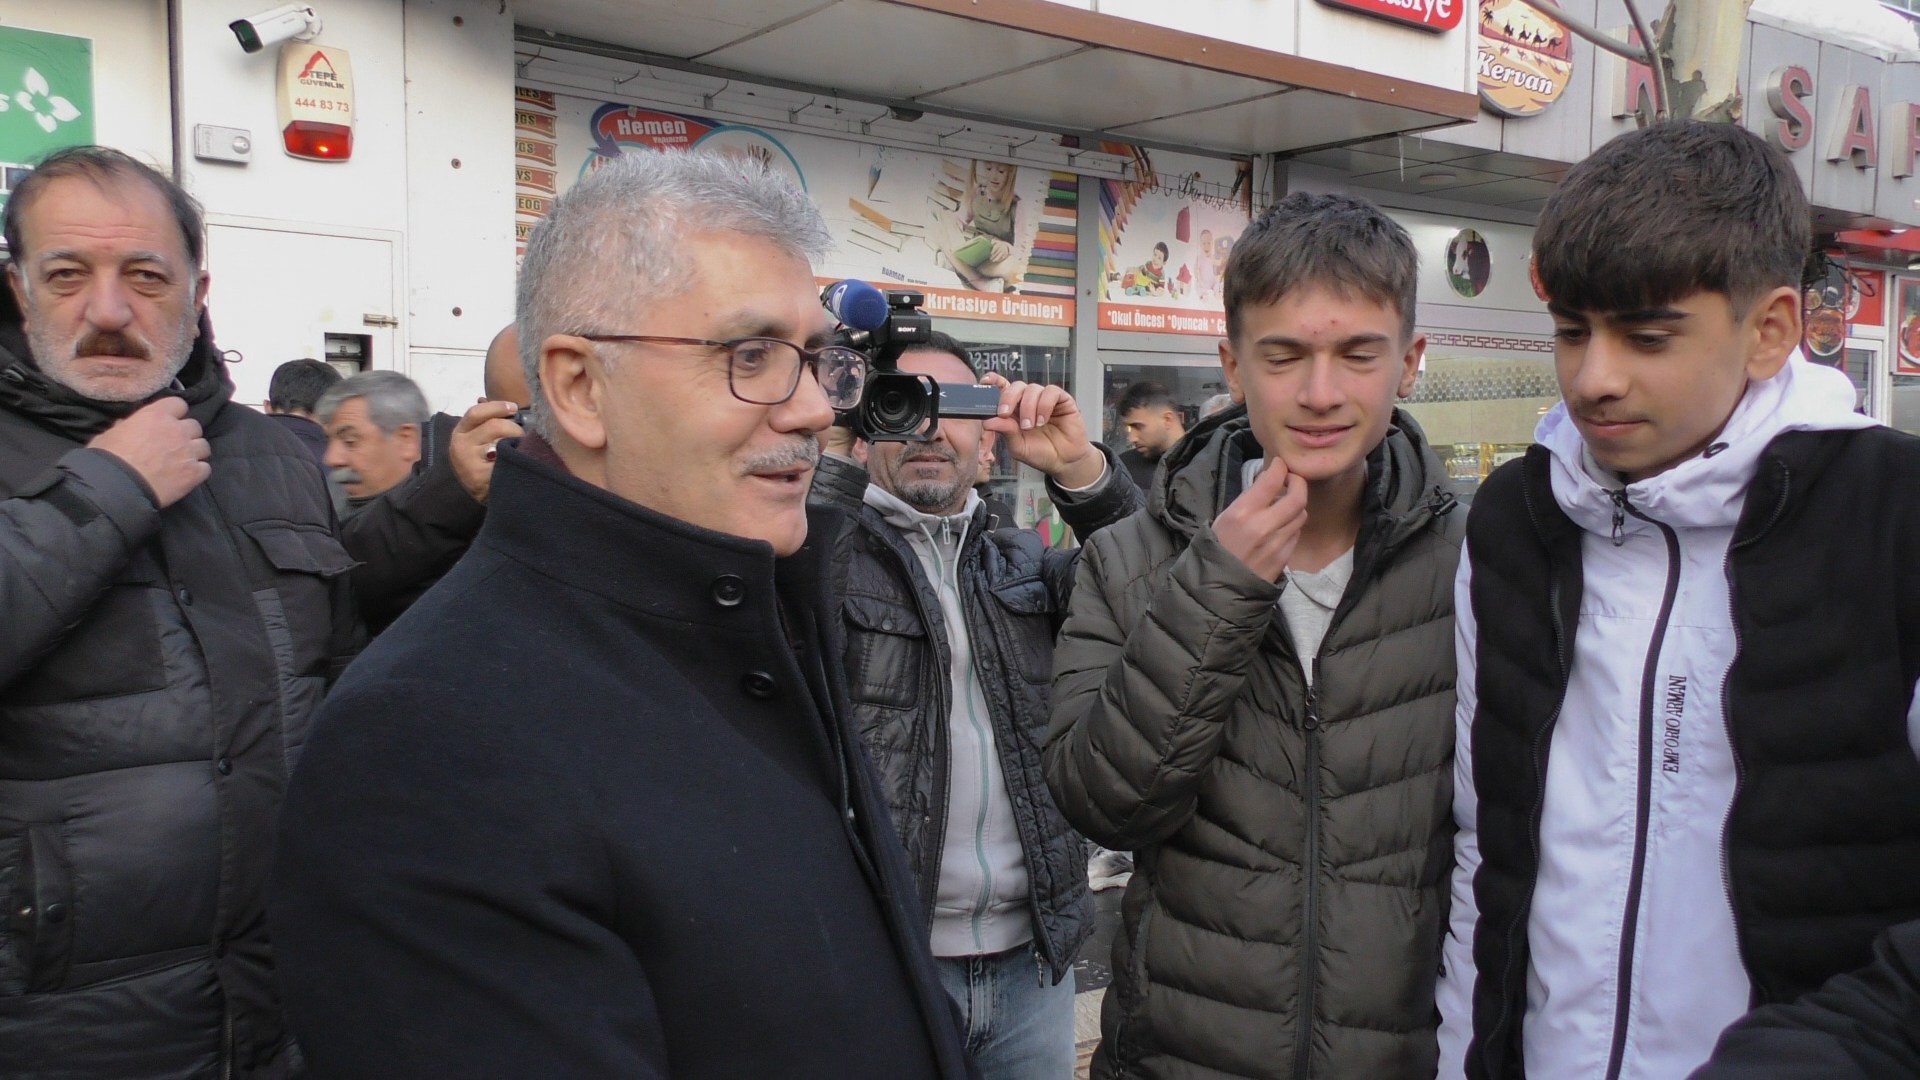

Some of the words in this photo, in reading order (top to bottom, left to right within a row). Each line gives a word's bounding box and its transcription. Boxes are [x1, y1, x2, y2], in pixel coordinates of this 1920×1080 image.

[310, 70, 338, 81] TEPE
[1477, 50, 1553, 95] Kervan
[295, 98, 316, 107] 444
[320, 99, 334, 110] 83
[336, 101, 350, 112] 73
[617, 119, 687, 135] Hemen
[1002, 296, 1064, 320] Ürünleri
[1134, 309, 1165, 329] Öncesi
[1666, 675, 1687, 718] ARMANI
[1662, 718, 1680, 774] EMPORIO
